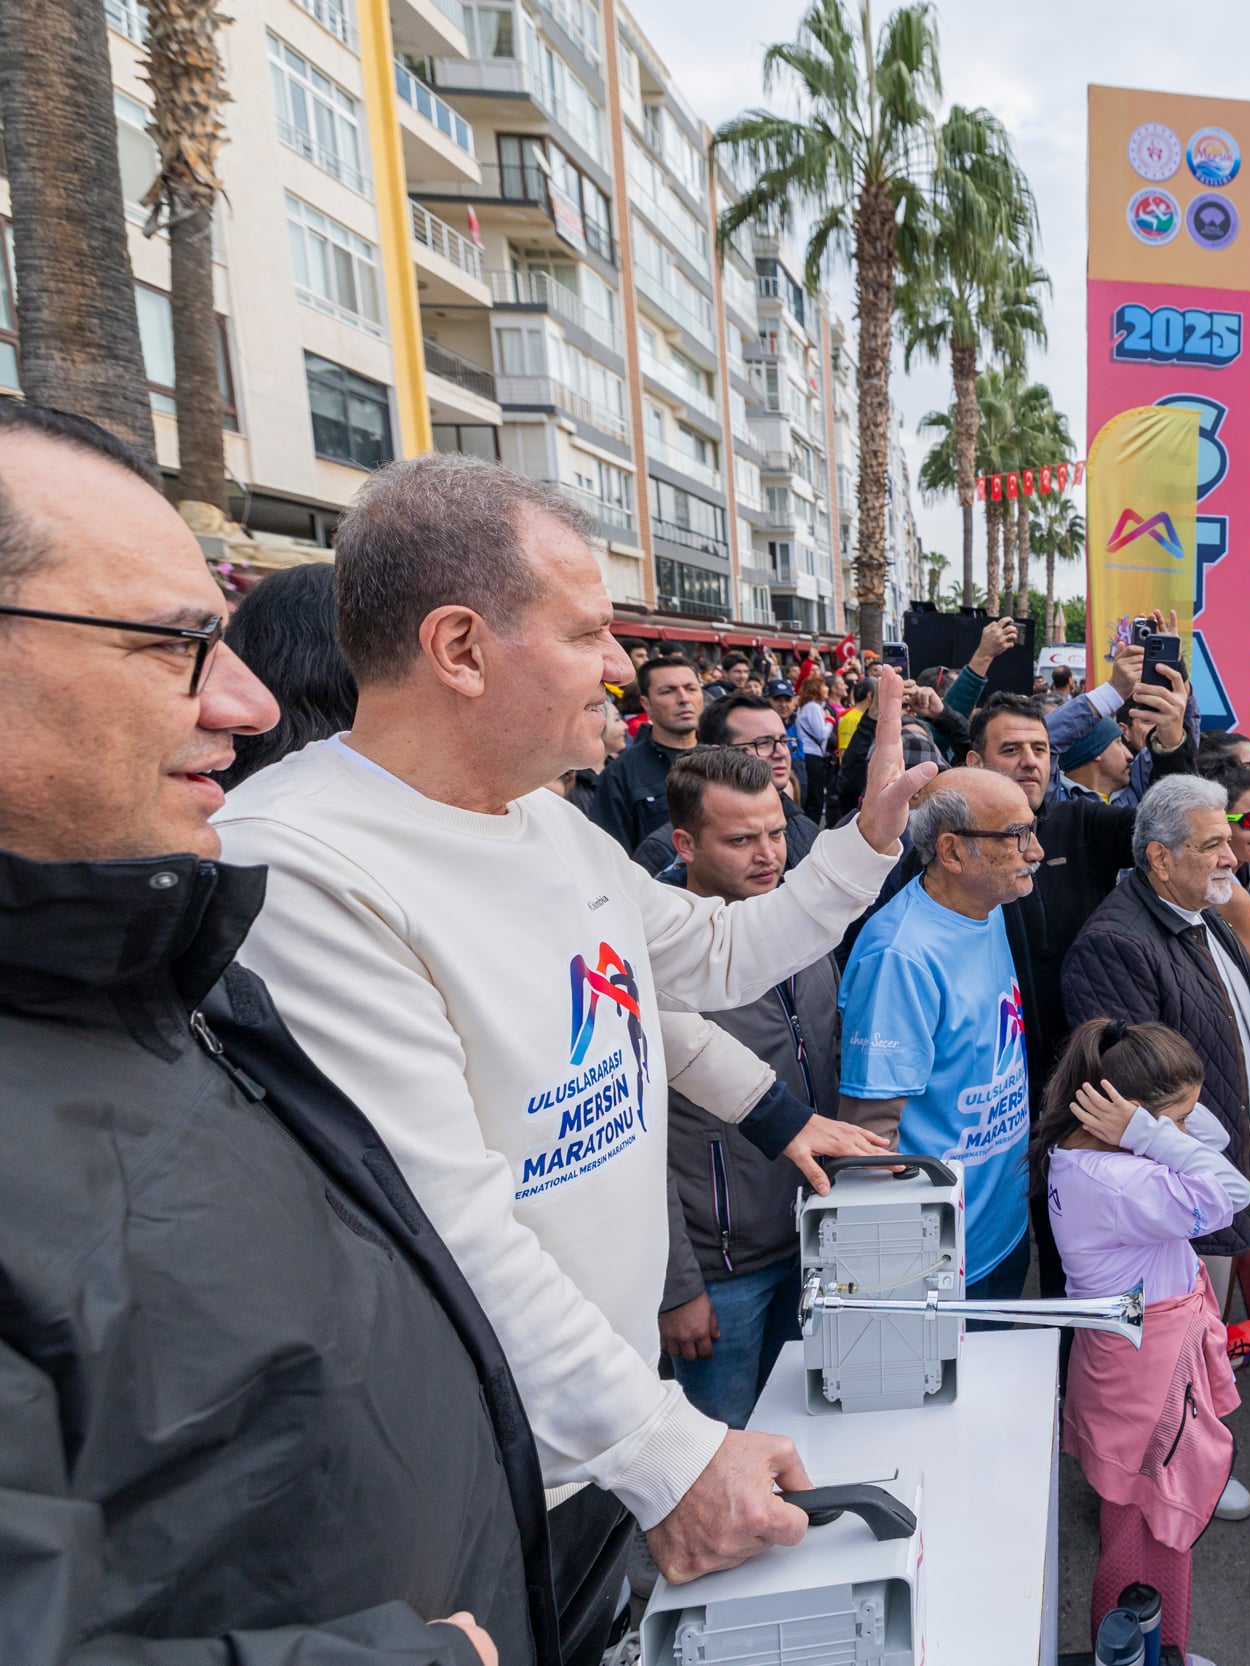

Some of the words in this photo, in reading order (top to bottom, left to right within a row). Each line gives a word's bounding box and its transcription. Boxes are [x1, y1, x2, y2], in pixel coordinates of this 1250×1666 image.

[1112, 303, 1243, 366] 2025
[527, 1049, 622, 1114] ULUSLARARASI
[558, 1073, 629, 1140] MERSİN
[987, 1085, 1025, 1125] MERS
[522, 1106, 633, 1183] MARATONU
[966, 1107, 1027, 1149] MARATON
[515, 1170, 578, 1200] ERNATIONAL
[580, 1153, 607, 1175] MERSIN
[607, 1134, 636, 1160] MARATHON
